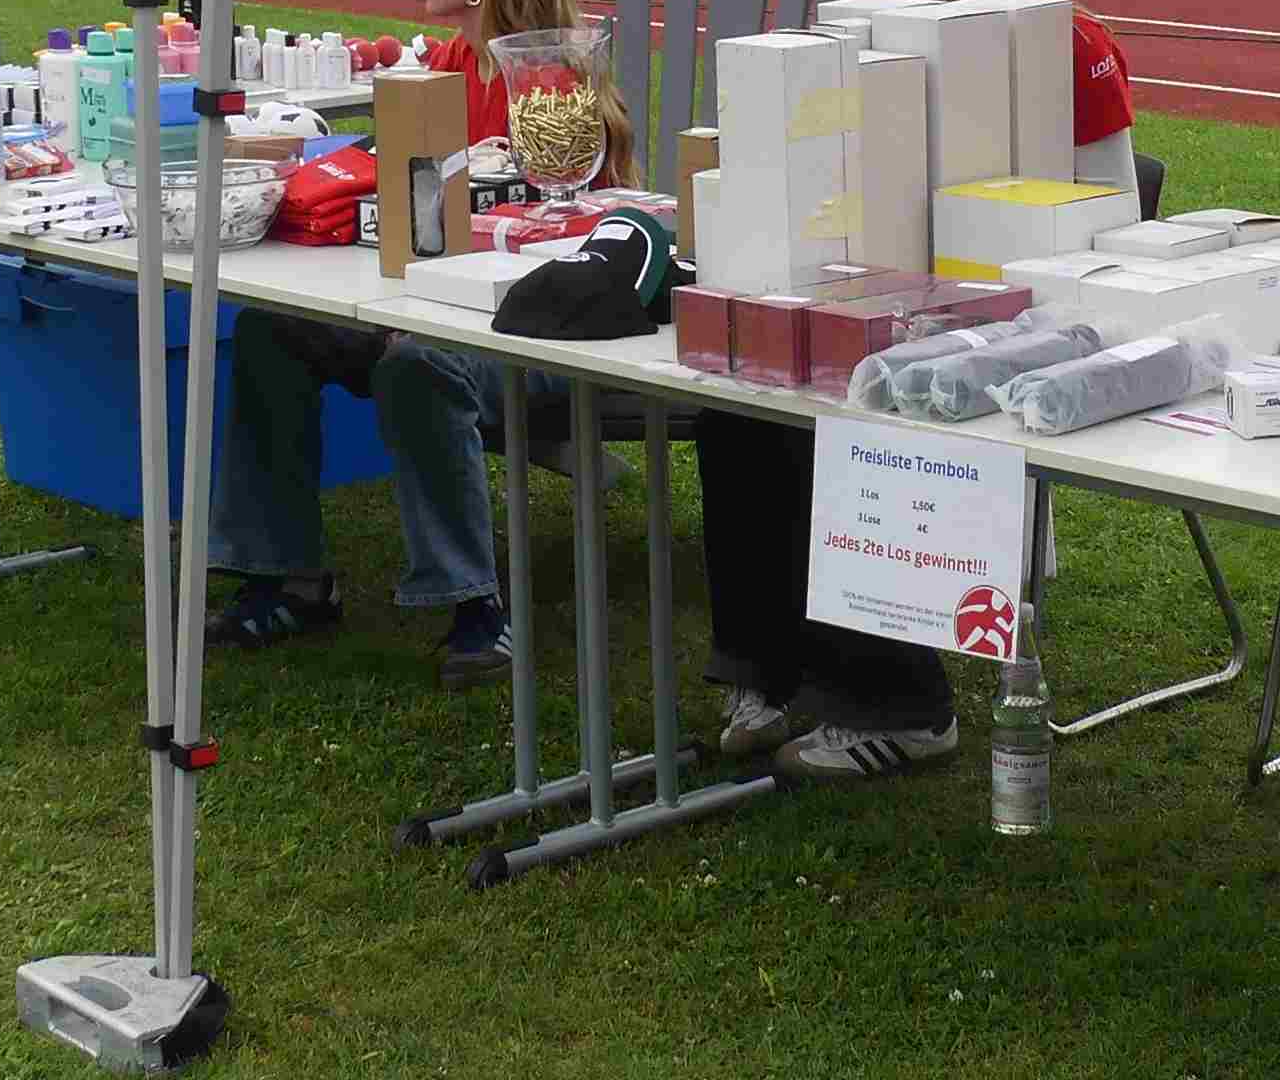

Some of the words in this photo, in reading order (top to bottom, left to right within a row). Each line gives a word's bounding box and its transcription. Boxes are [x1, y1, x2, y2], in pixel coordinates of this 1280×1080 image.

[851, 445, 912, 471] Preisliste
[915, 456, 979, 482] Tombola
[865, 489, 880, 502] Los
[824, 531, 861, 553] Jedes
[863, 539, 884, 557] 2te
[887, 544, 911, 563] Los
[914, 548, 988, 577] gewinnt!!!
